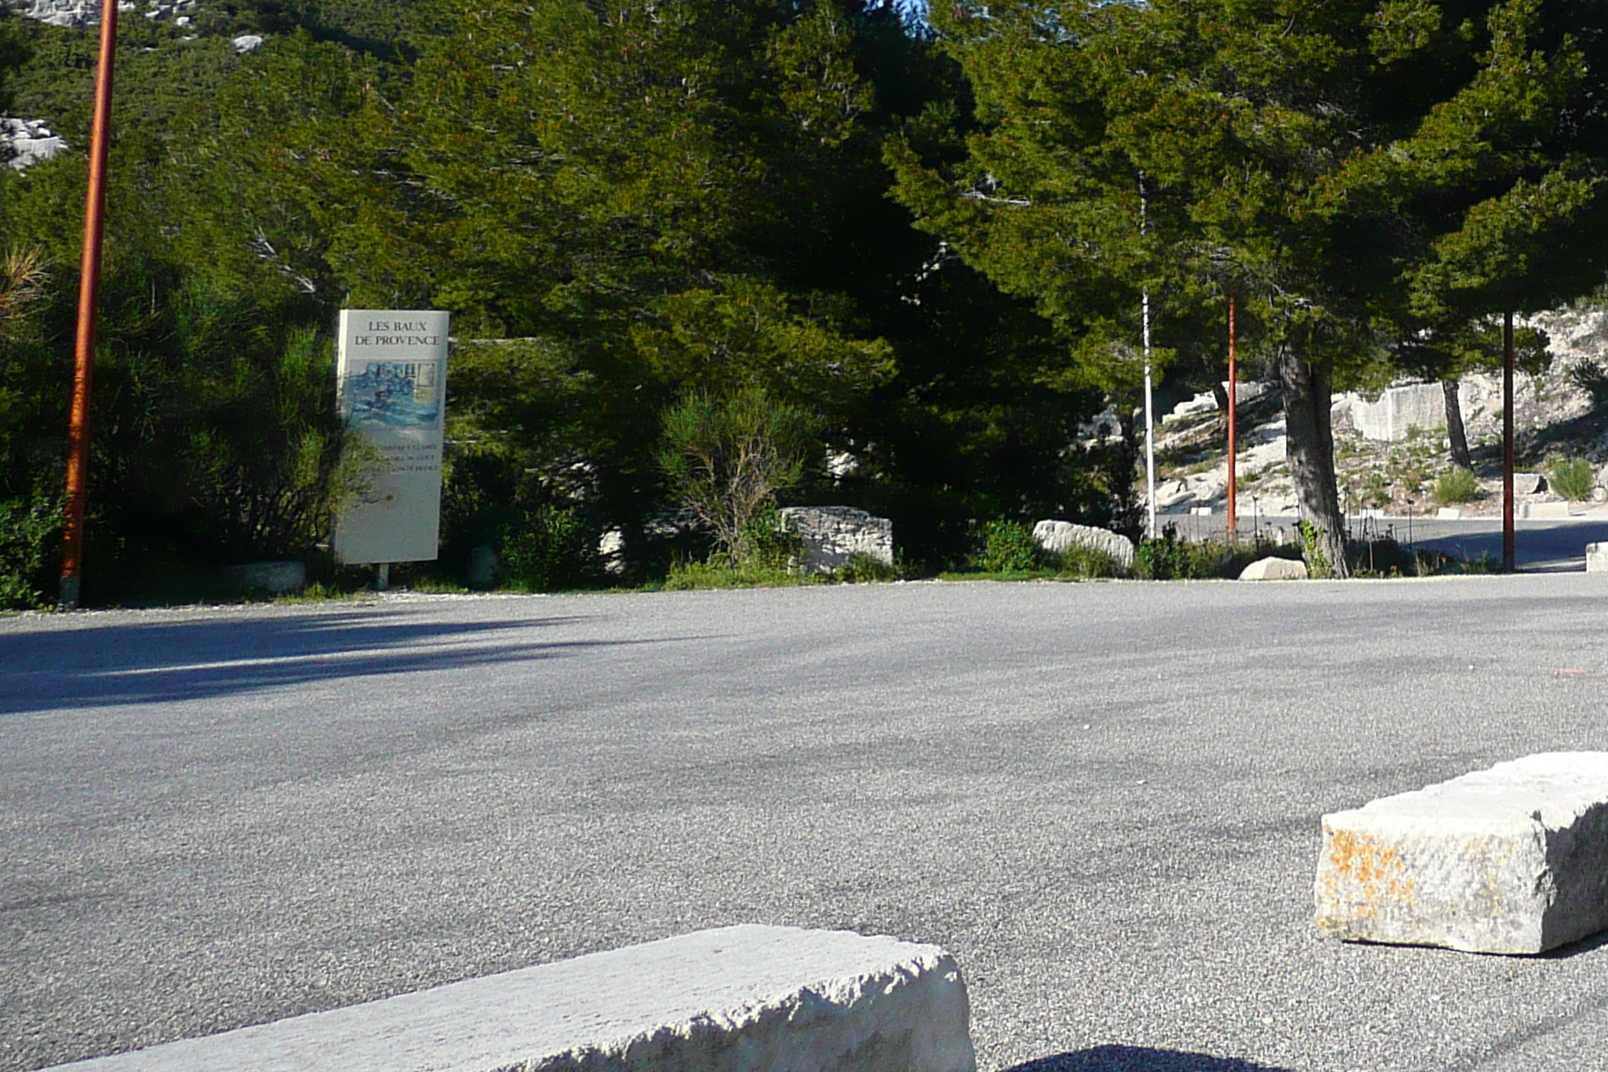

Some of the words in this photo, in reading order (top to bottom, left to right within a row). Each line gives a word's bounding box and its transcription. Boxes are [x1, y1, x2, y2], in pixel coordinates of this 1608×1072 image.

[369, 321, 390, 332] LES
[394, 321, 427, 332] BAUX
[355, 335, 372, 346] DE
[376, 335, 441, 346] PROVENCE
